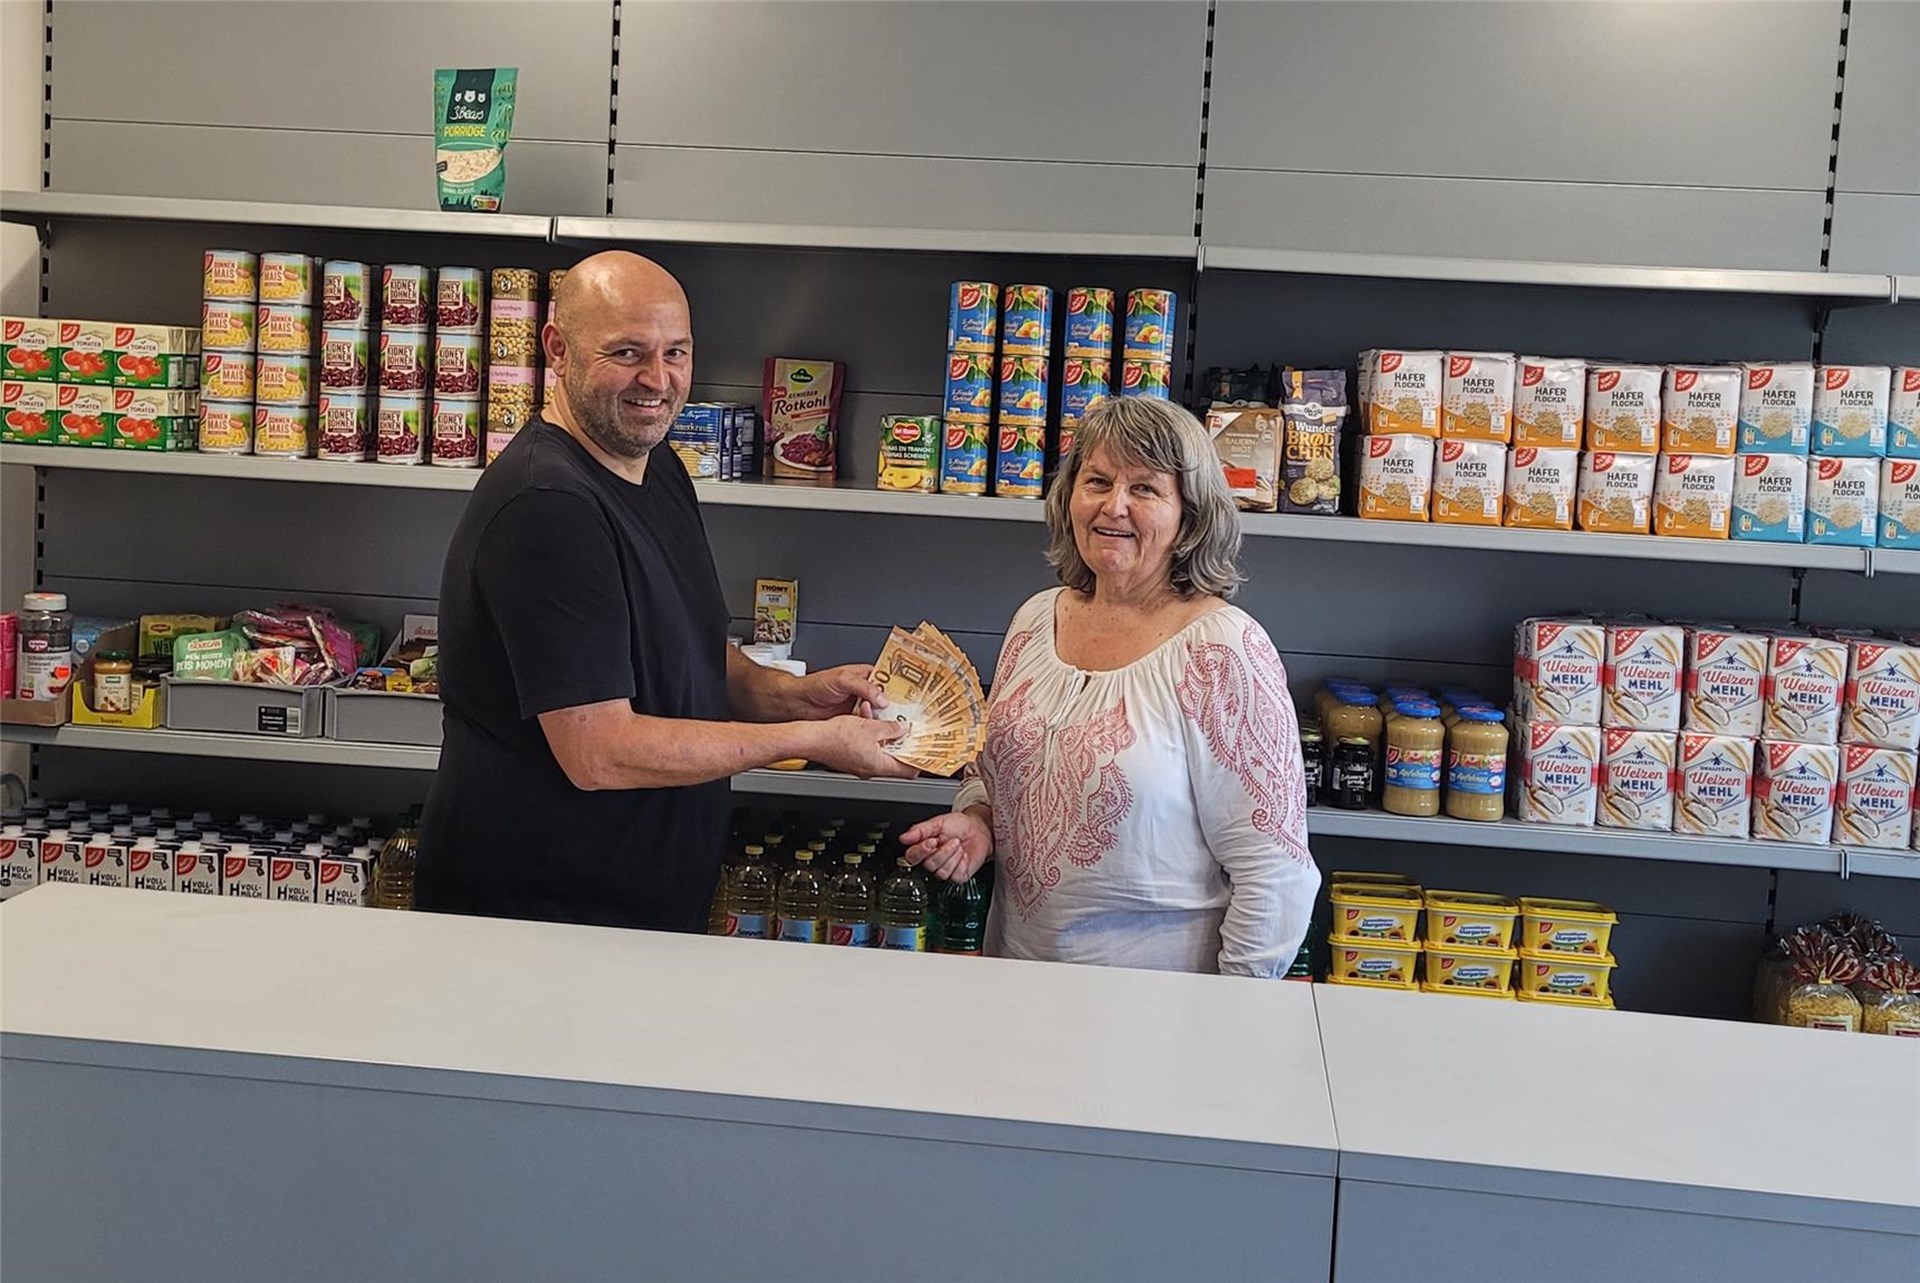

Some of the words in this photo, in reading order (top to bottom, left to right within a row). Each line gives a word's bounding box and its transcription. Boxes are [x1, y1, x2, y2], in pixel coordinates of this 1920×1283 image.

[444, 126, 486, 137] PORRIDGE
[214, 269, 235, 278] MAIS
[264, 272, 282, 281] MAIS
[209, 319, 228, 328] MAIS
[270, 322, 291, 332] MAIS
[223, 370, 244, 380] MAIS
[264, 373, 283, 383] MAIS
[1395, 373, 1425, 382] HAFER
[1463, 378, 1494, 387] HAFER
[1536, 387, 1567, 396] HAFER
[1612, 392, 1644, 400] HAFER
[1689, 392, 1721, 401] HAFER
[1763, 390, 1796, 399] HAFER
[1841, 390, 1873, 399] HAFER
[774, 396, 826, 415] Rotkohl
[208, 420, 228, 430] MAIS
[269, 424, 290, 433] MAIS
[1296, 421, 1336, 433] Wunder
[1287, 445, 1334, 460] CHEN
[1383, 459, 1414, 467] HAFER
[1456, 462, 1487, 471] HAFER
[1529, 468, 1560, 477] HAFER
[1607, 473, 1638, 482] HAFER
[1683, 474, 1715, 483] HAFER
[1760, 477, 1792, 486] HAFER
[1834, 481, 1866, 490] HAFER
[196, 658, 233, 670] MOMENT
[1543, 659, 1592, 674] Weizen
[1620, 664, 1670, 679] Weizen
[1551, 674, 1586, 685] MEHL
[1702, 670, 1754, 686] Weizen
[1628, 680, 1663, 690] MEHL
[1780, 678, 1832, 694] Weizen
[1863, 681, 1915, 698] Weizen
[1710, 685, 1746, 697] MEHL
[1788, 693, 1824, 705] MEHL
[1869, 697, 1907, 709] MEHL
[1537, 760, 1586, 774] Weizen
[1613, 764, 1663, 780] Weizen
[1544, 774, 1579, 785] MEHL
[1689, 771, 1741, 786] Weizen
[1620, 780, 1656, 791] MEHL
[1774, 779, 1826, 795] Weizen
[1852, 782, 1904, 798] Weizen
[1697, 786, 1734, 797] MEHL
[1781, 794, 1817, 806] MEHL
[1860, 797, 1896, 808] MEHL
